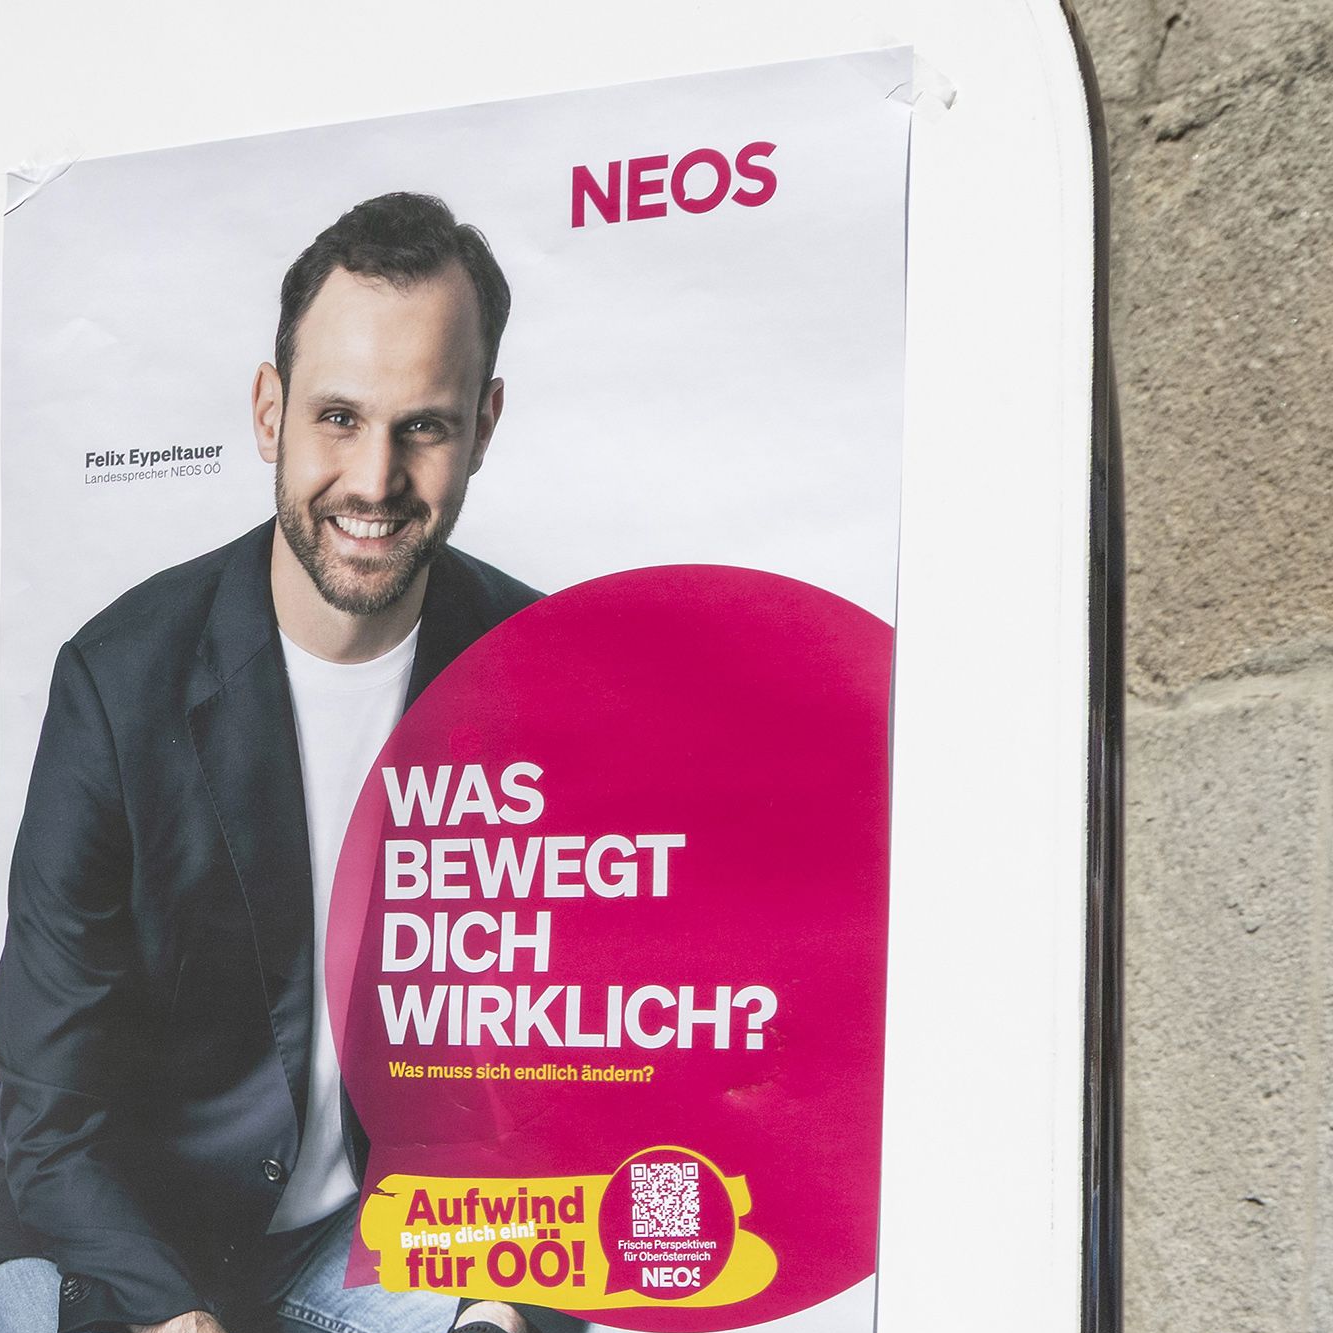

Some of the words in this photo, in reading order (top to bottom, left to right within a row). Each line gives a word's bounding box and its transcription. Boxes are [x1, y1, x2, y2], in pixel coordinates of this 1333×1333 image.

[572, 141, 777, 228] NEOS
[85, 469, 169, 484] Landessprecher
[170, 464, 202, 477] NEOS
[203, 461, 221, 475] OÖ
[86, 451, 125, 468] Felix
[129, 445, 223, 467] Eypeltauer
[382, 762, 544, 826] WAS
[384, 834, 686, 900] BEWEGT
[382, 911, 551, 972] DICH
[378, 985, 778, 1050] WIRKLICH?
[389, 1061, 424, 1078] Was
[427, 1064, 472, 1079] muss
[476, 1062, 511, 1080] sich
[514, 1063, 577, 1081] endlich
[581, 1064, 654, 1082] ändern?
[405, 1186, 585, 1226] Aufwind
[400, 1231, 451, 1249] Bring
[455, 1225, 495, 1243] dich
[500, 1221, 536, 1239] ein!
[618, 1240, 653, 1250] Frische
[654, 1240, 716, 1250] Perspektiven
[406, 1247, 475, 1288] für
[487, 1229, 585, 1288] OÖ!
[624, 1251, 638, 1261] für
[639, 1251, 711, 1261] Oberösterreich
